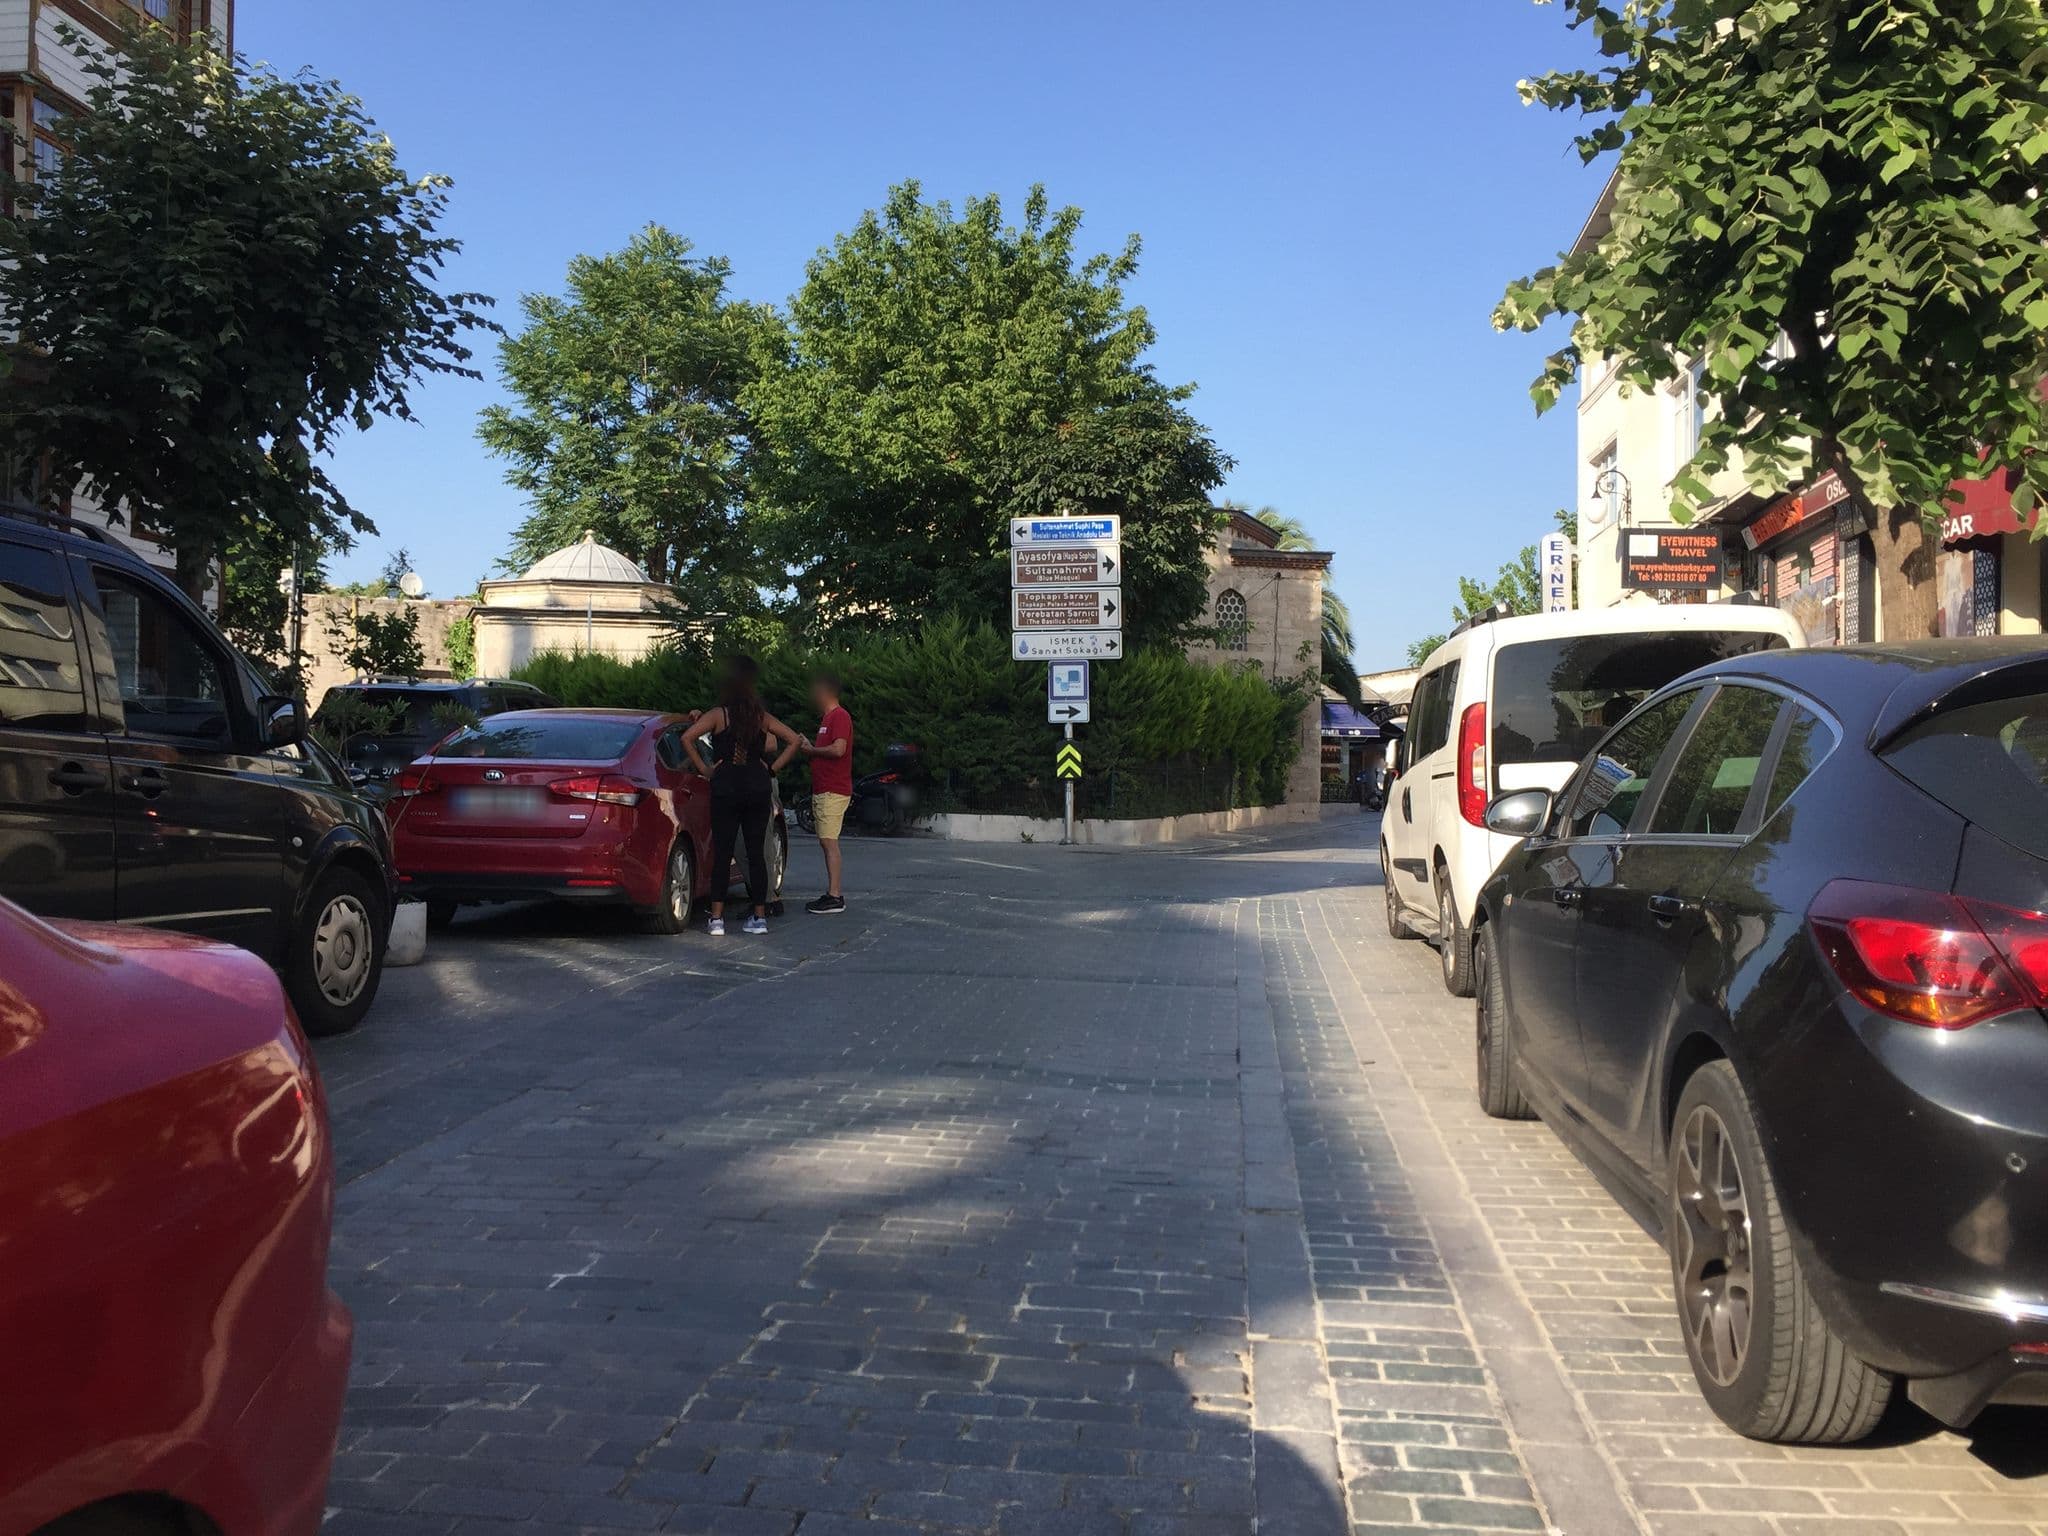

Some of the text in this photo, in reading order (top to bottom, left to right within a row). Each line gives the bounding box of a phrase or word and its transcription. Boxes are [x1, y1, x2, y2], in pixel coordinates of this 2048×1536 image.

[1040, 522, 1074, 531] Sultanahmet
[1075, 522, 1091, 530] Suphi
[1076, 531, 1098, 539] Anadolu
[1660, 535, 1717, 547] EYEWITNESS
[1670, 548, 1707, 557] TRAVEL
[1018, 551, 1062, 564] Ayasofya
[1025, 566, 1093, 575] Sultanahmet
[1664, 573, 1676, 582] 212
[1025, 592, 1093, 602] Topkapı Sarayı
[1020, 609, 1098, 618] Yerebatan Sarnıcı
